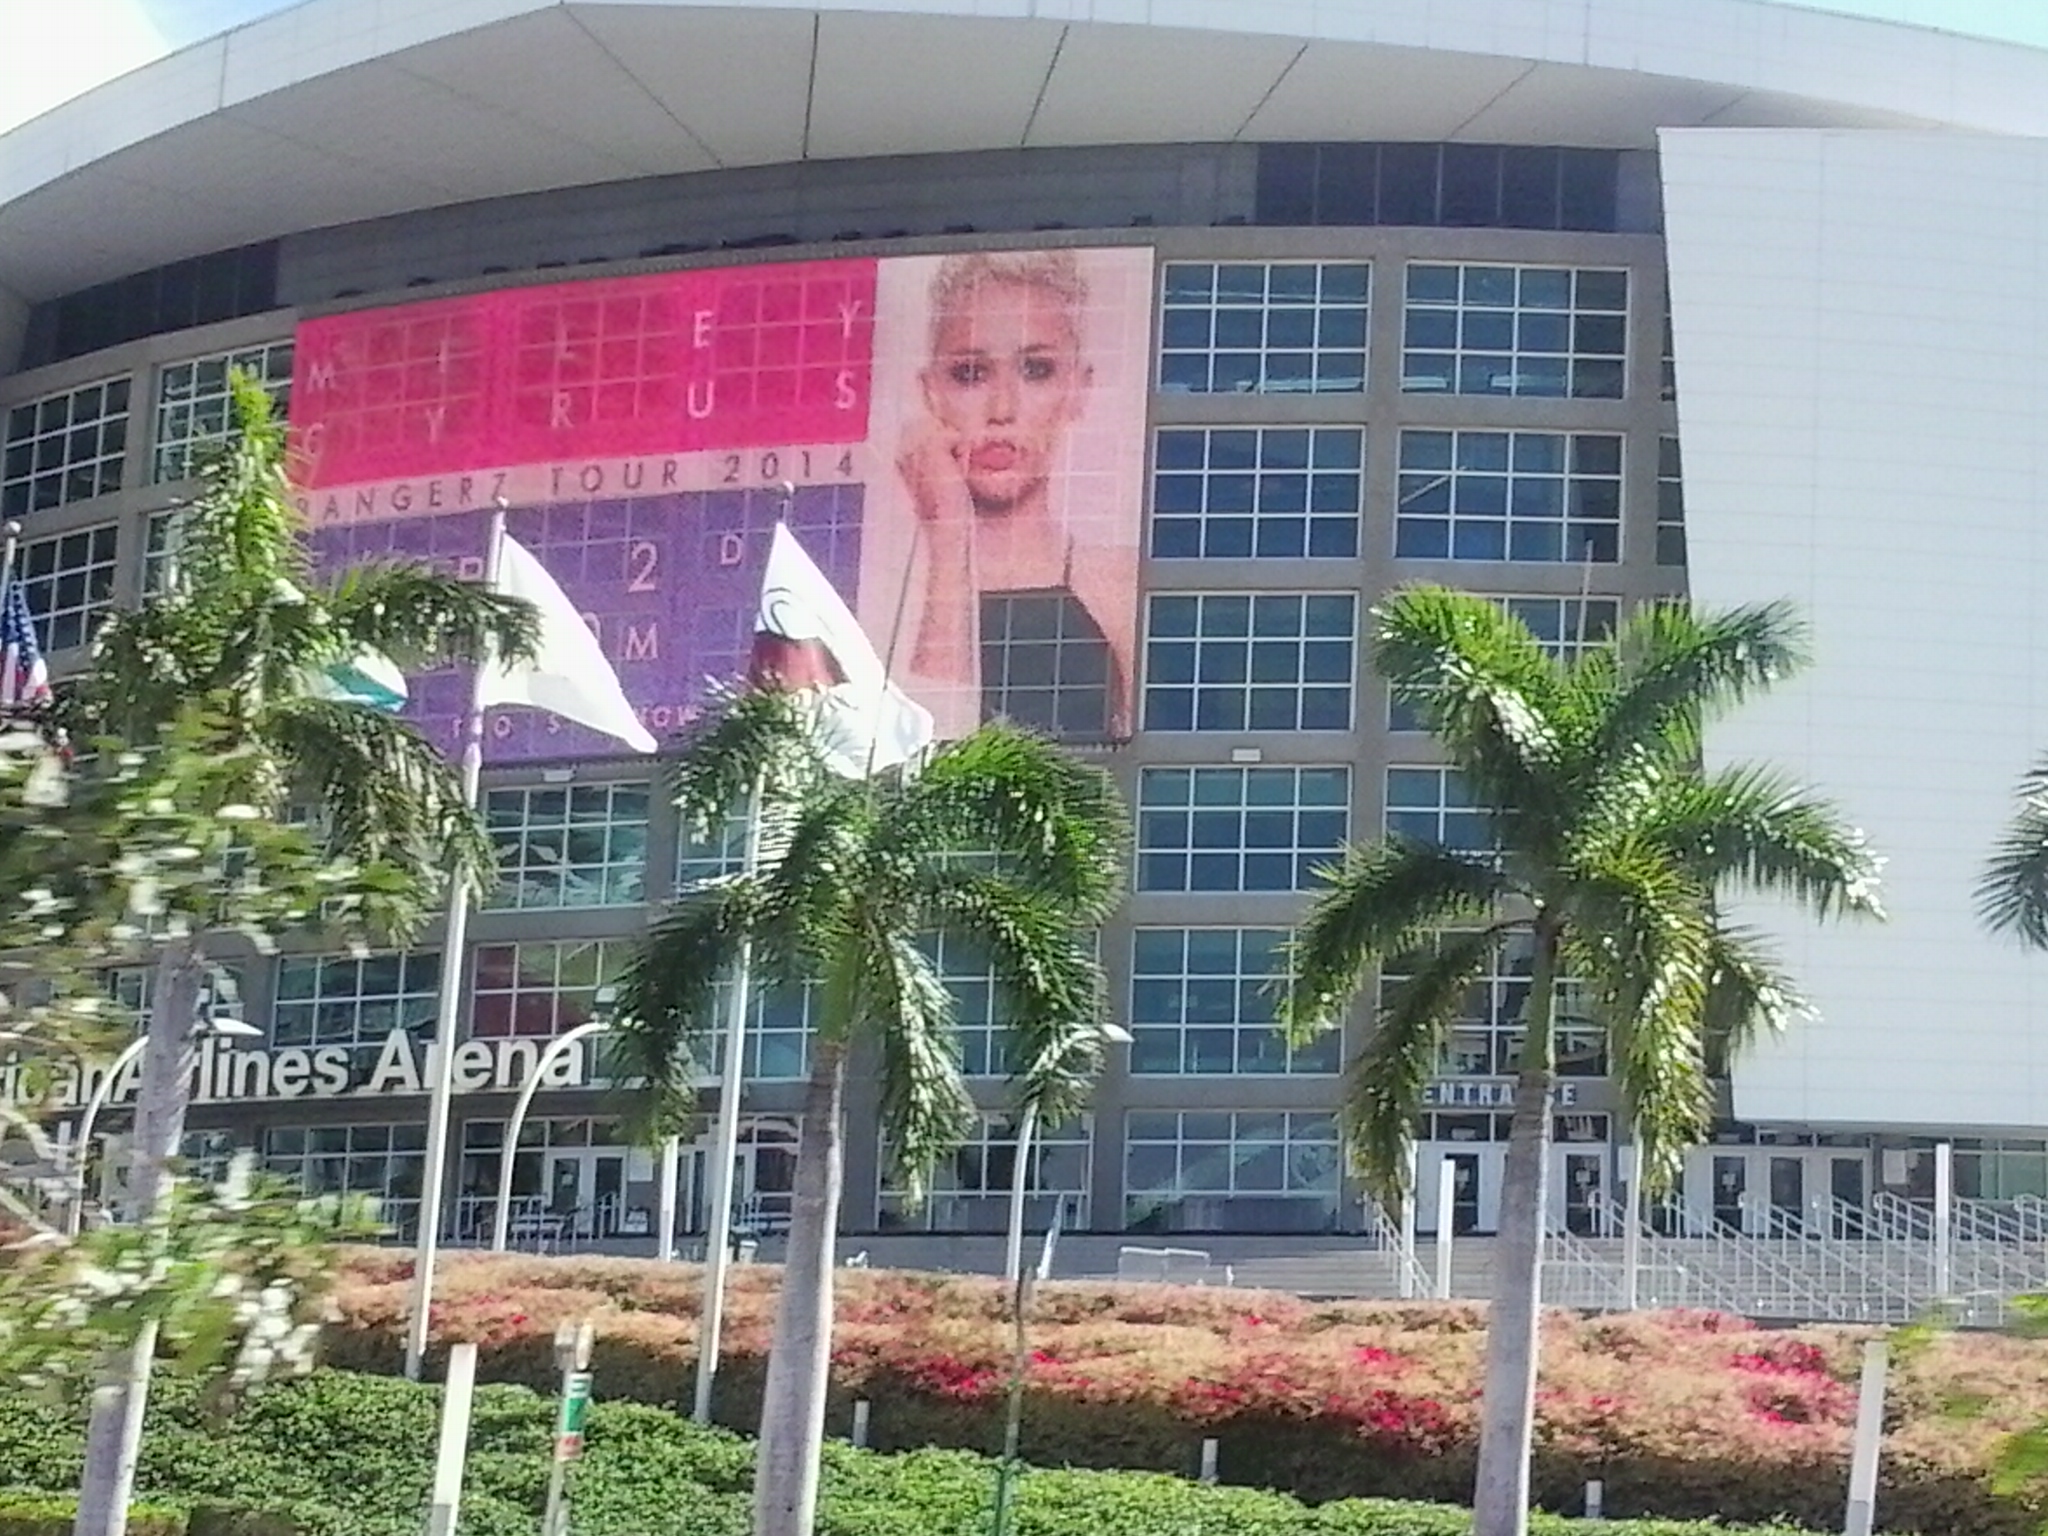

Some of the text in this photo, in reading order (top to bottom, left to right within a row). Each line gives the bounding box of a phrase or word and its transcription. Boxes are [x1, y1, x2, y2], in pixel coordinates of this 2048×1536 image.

[306, 300, 861, 395] MILEY
[302, 370, 856, 455] CYRUS
[551, 460, 678, 494] TOUR
[723, 451, 853, 484] 2014
[368, 1028, 584, 1091] Arena
[1422, 1082, 1576, 1106] ENTRAE
